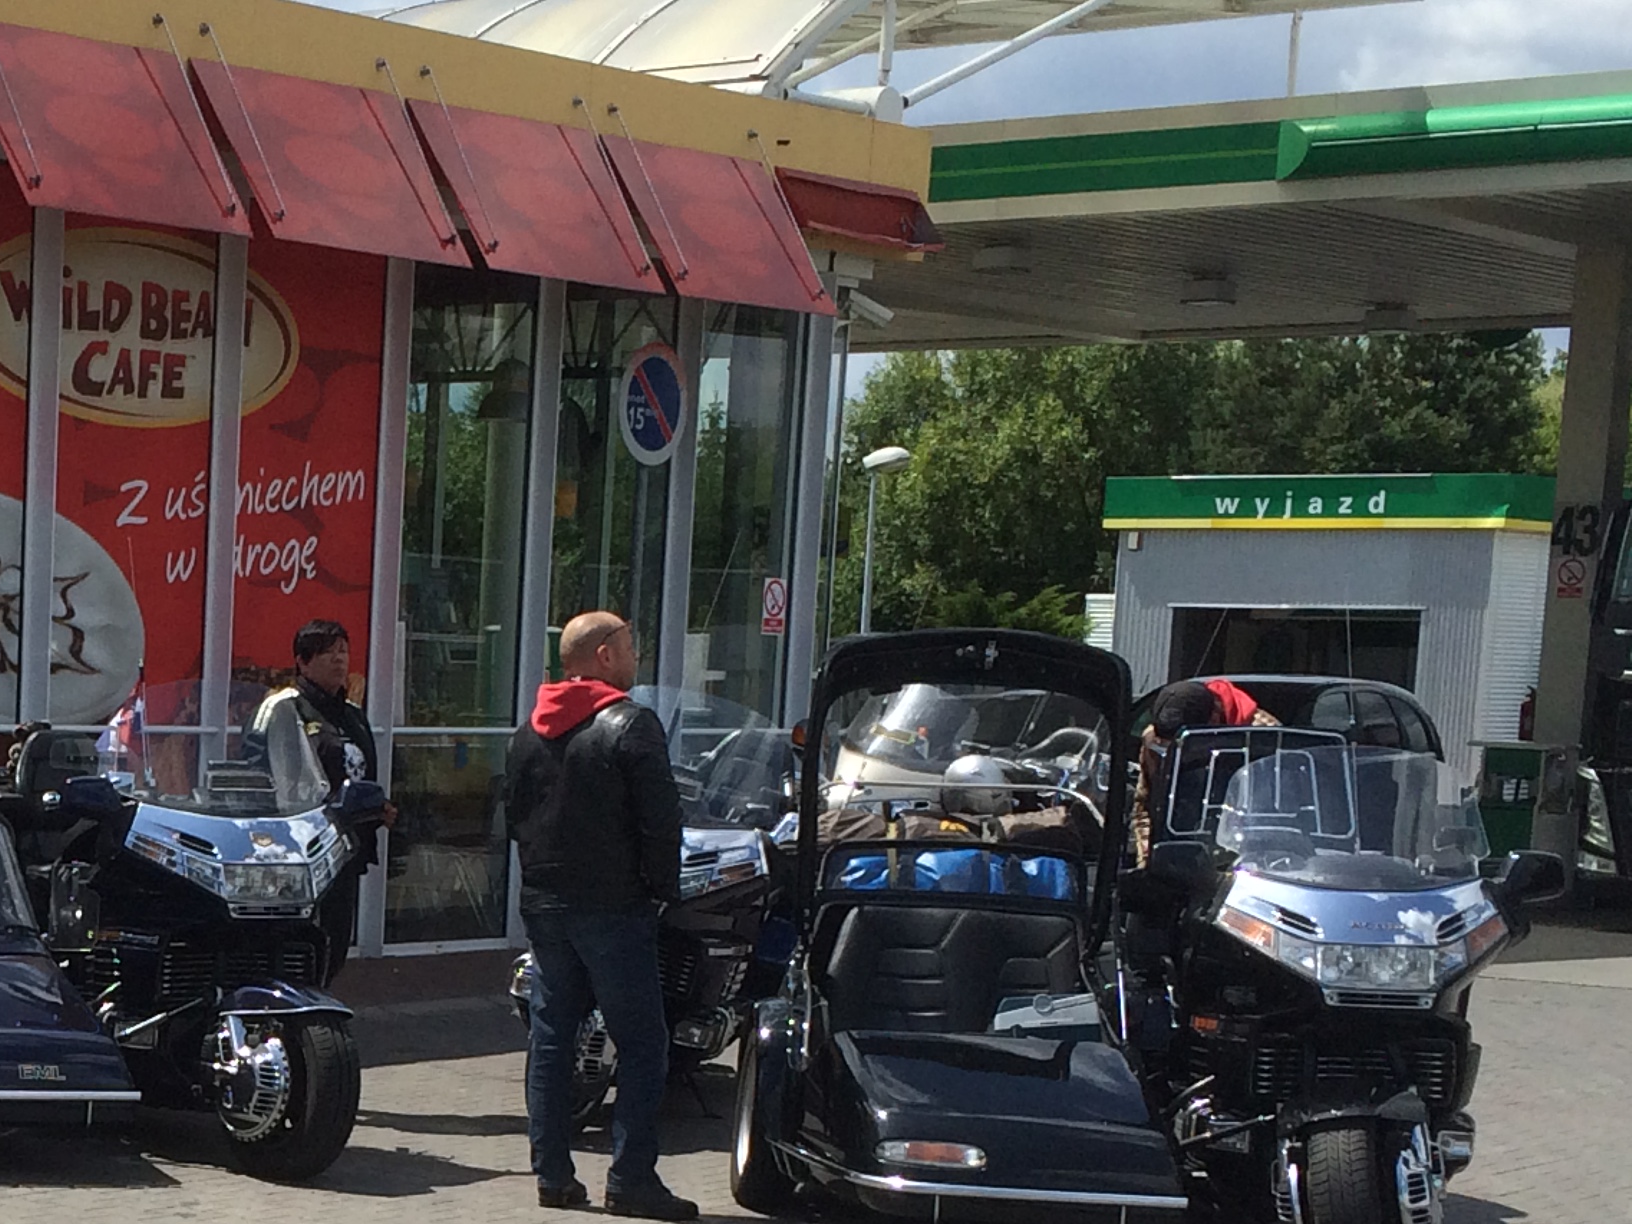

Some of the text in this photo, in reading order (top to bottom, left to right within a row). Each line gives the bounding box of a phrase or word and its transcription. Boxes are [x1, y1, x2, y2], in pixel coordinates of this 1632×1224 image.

[139, 280, 254, 347] BEA
[71, 340, 187, 399] CAFE
[628, 405, 645, 431] 15
[1214, 489, 1386, 520] wyjazd
[1551, 504, 1600, 557] 43
[166, 547, 197, 584] w
[18, 1064, 67, 1081] EML
